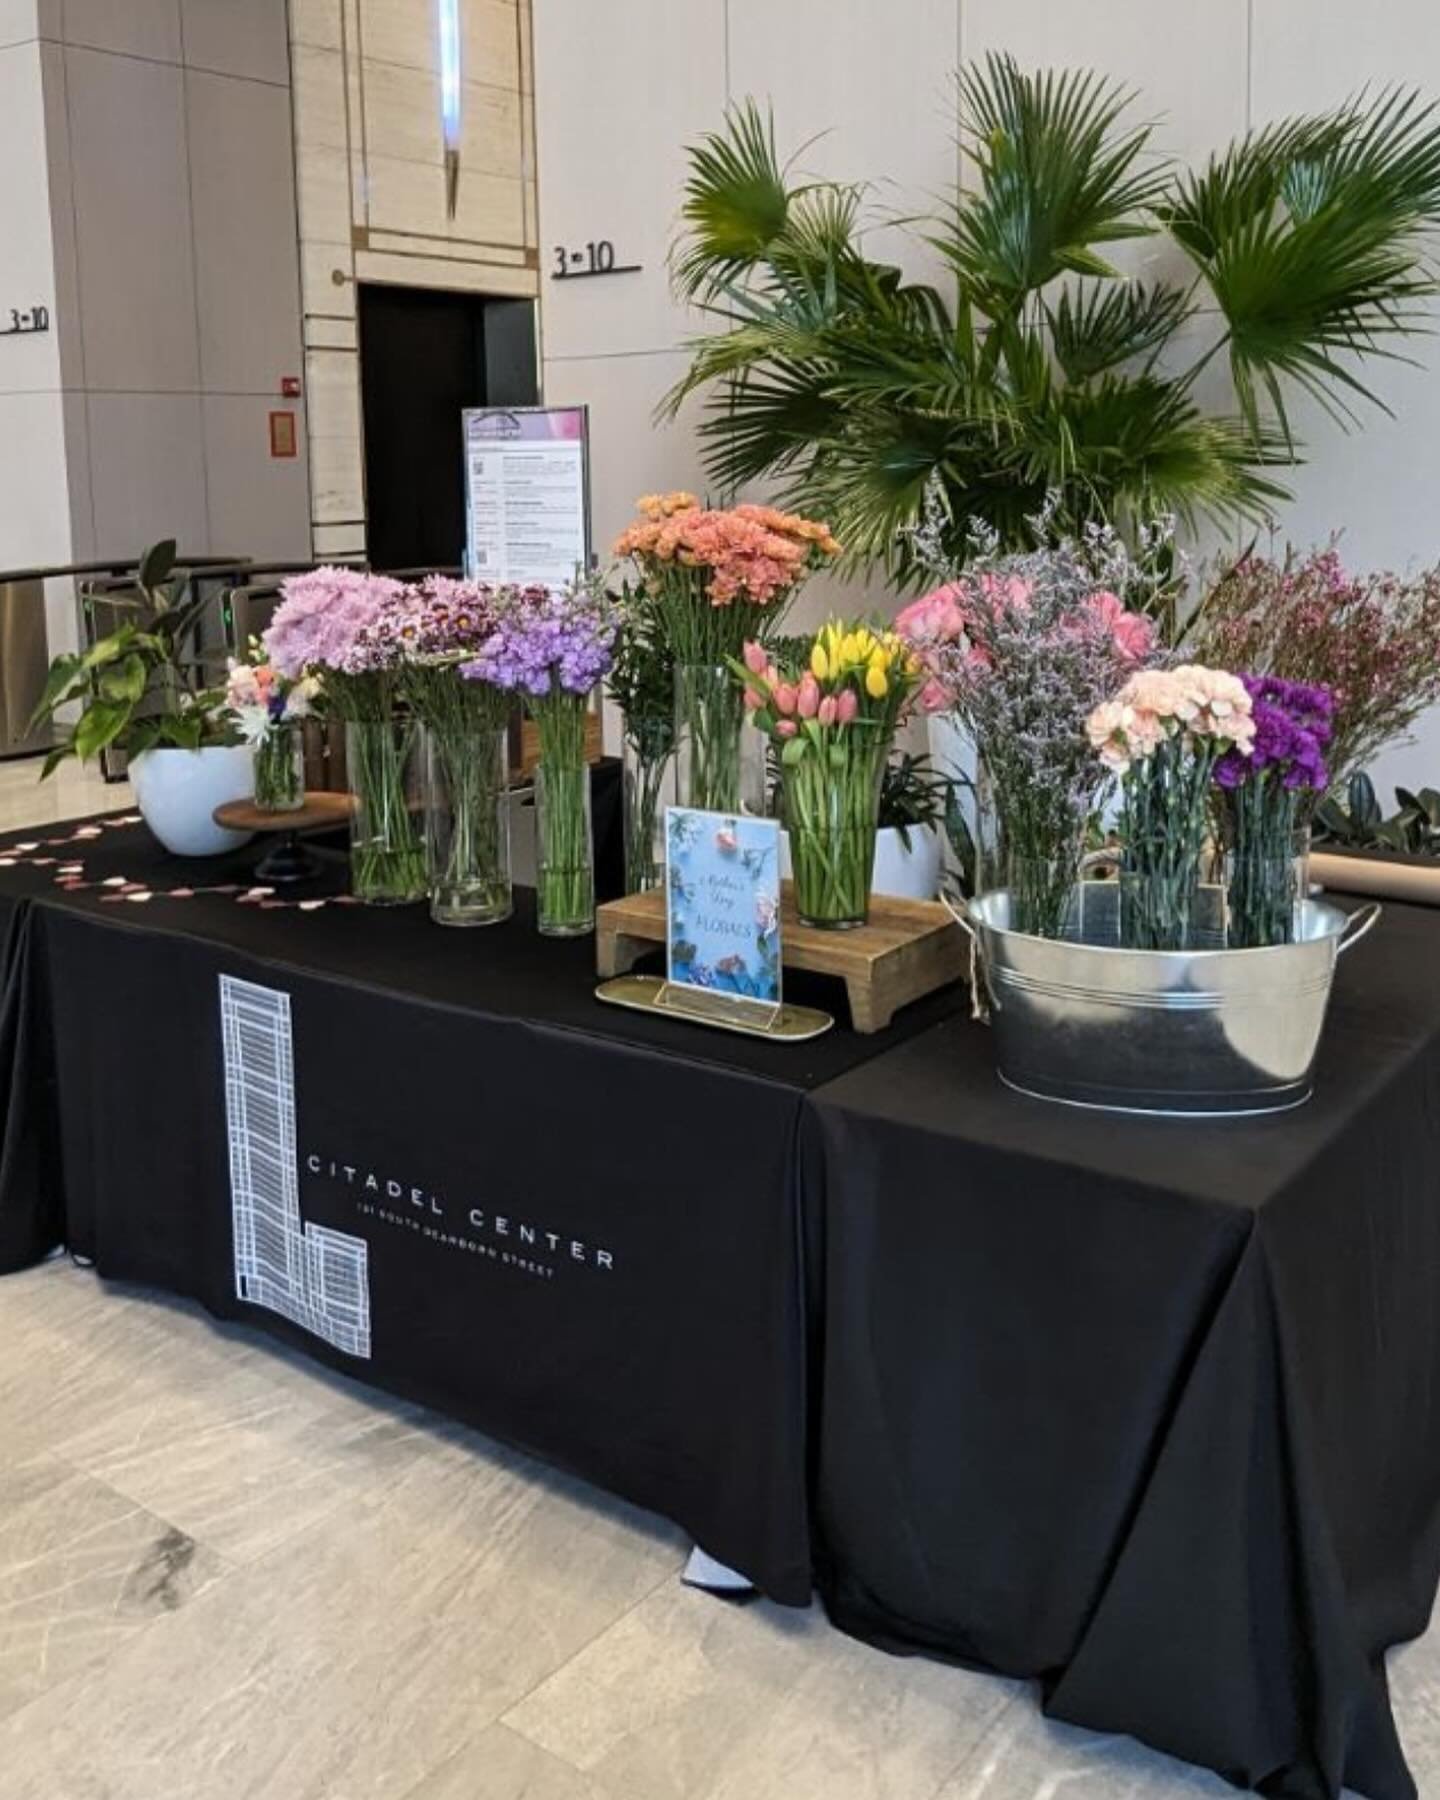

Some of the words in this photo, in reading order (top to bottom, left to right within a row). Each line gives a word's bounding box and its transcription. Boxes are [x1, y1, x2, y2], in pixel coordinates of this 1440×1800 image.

[554, 240, 615, 276] 3-10
[10, 306, 49, 331] 3-10
[307, 1154, 443, 1215] CITADEL
[469, 1208, 613, 1270] CENTER
[501, 1251, 554, 1279] STREET
